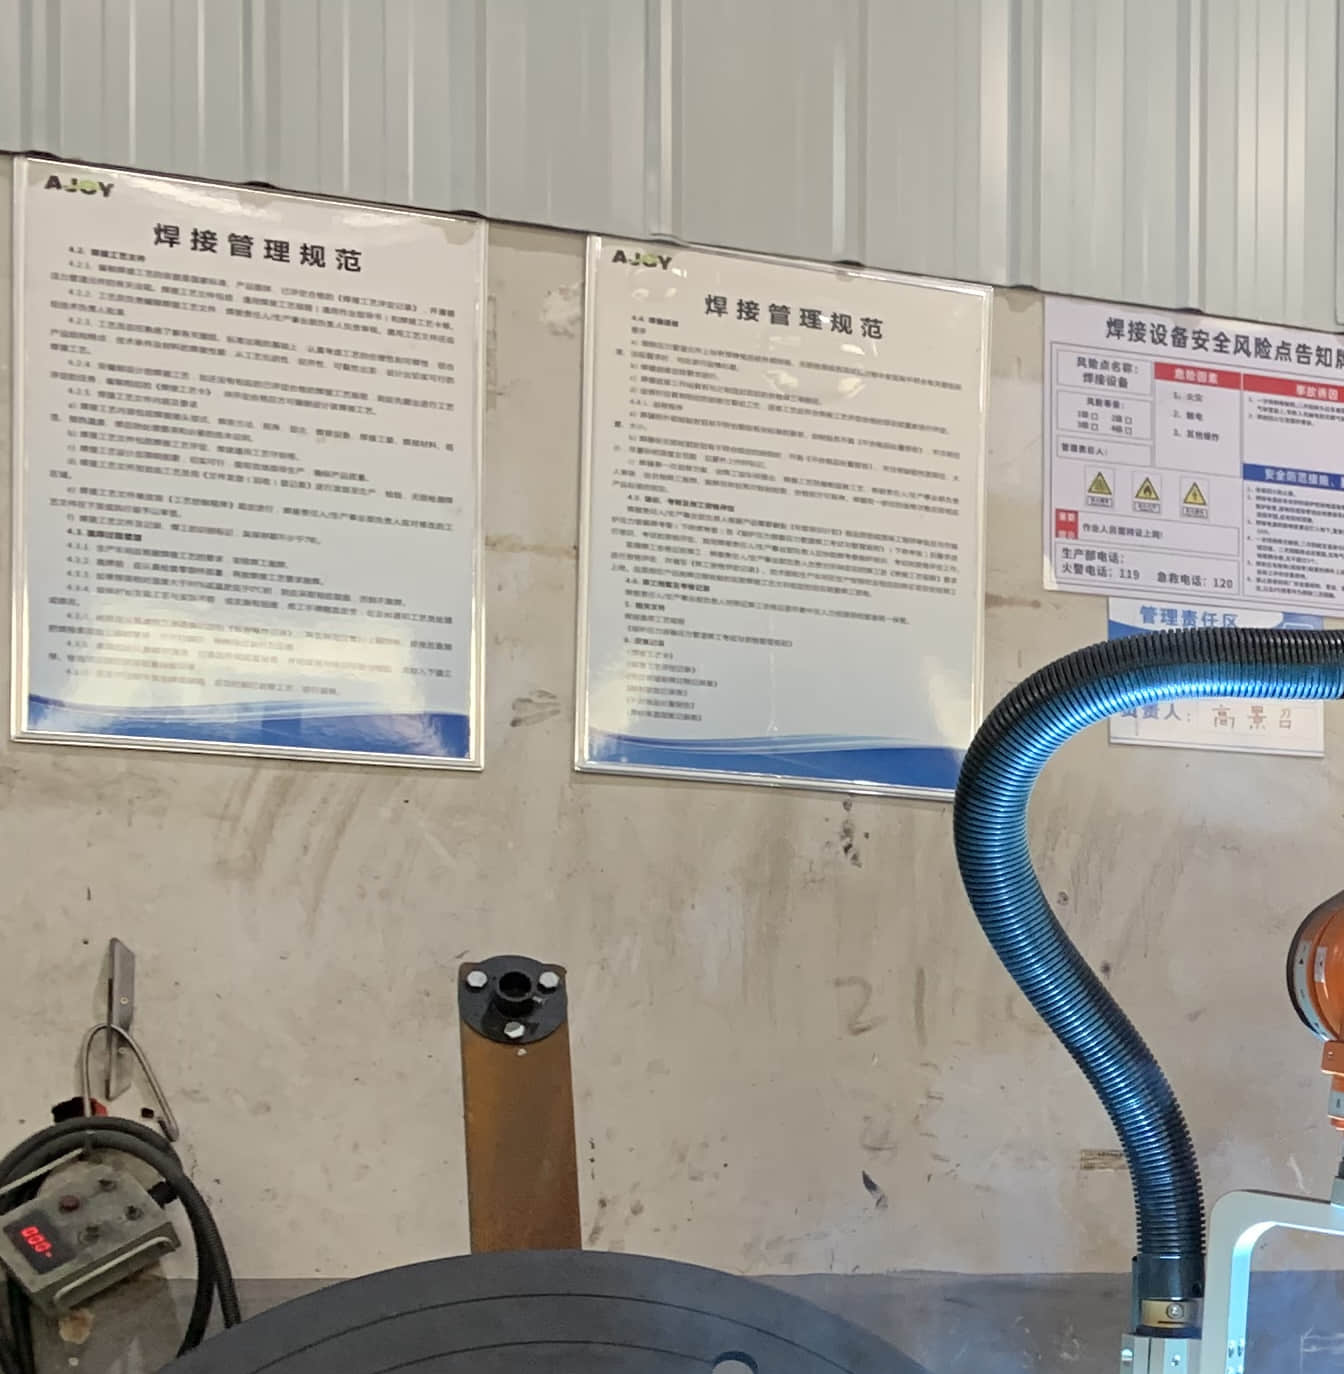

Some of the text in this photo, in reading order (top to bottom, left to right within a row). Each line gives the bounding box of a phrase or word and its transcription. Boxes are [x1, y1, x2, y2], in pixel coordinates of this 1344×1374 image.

[44, 175, 114, 197] AJOY
[153, 222, 362, 272] 焊接管理规范
[612, 250, 672, 270] AJOY
[704, 294, 884, 340] 焊接管理规范
[1083, 372, 1128, 389] 焊接设备
[1140, 605, 1240, 628] 管理责任区
